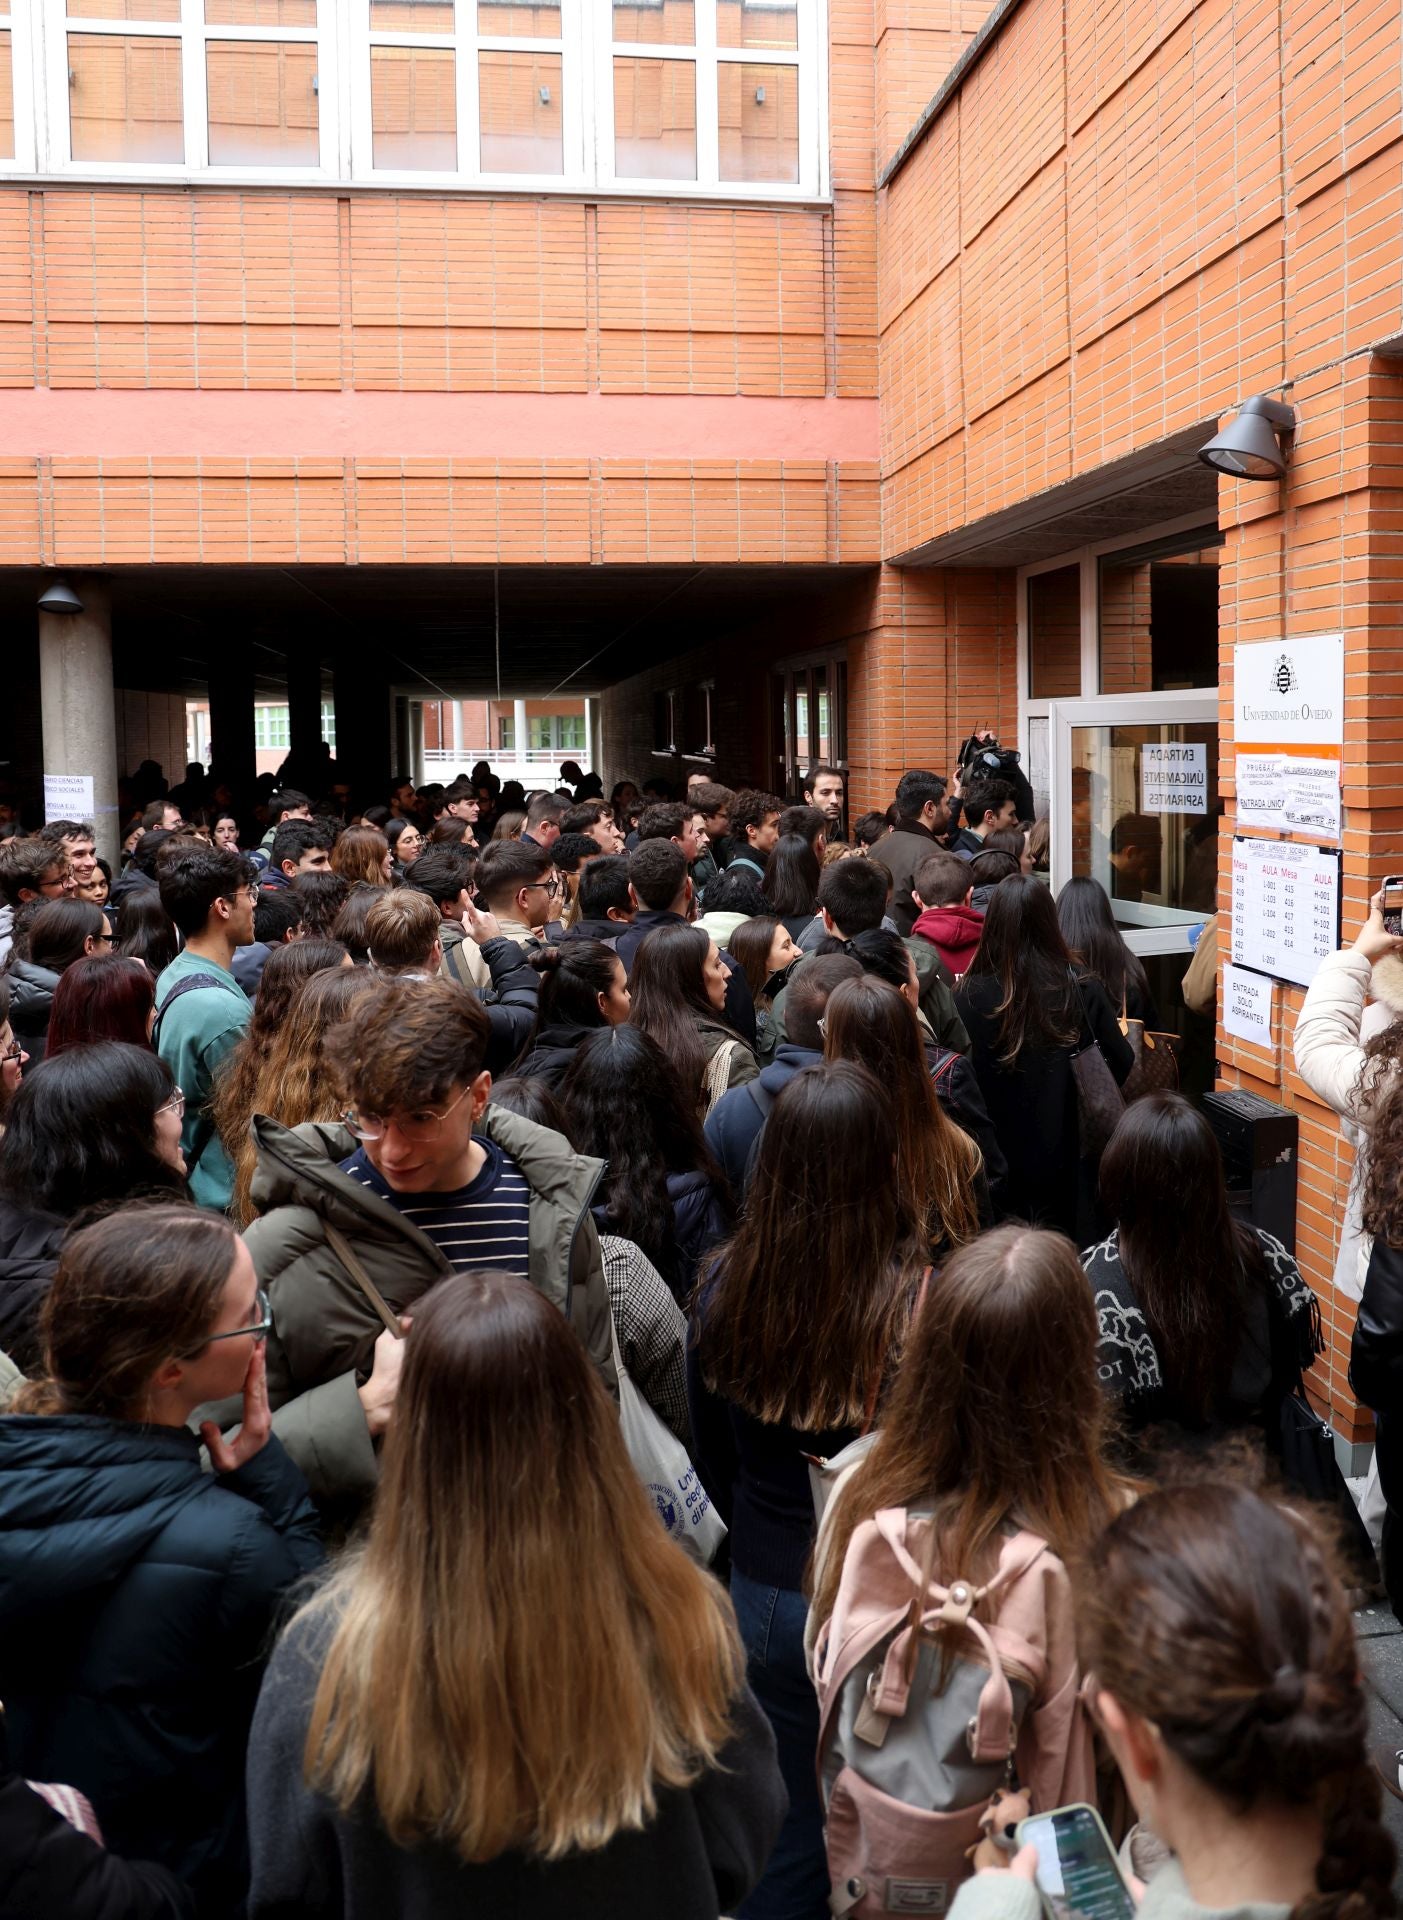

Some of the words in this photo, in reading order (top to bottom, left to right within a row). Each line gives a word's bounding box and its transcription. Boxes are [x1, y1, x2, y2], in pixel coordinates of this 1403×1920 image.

[1246, 763, 1275, 772] PRUEBAS
[1240, 798, 1266, 808] ENTRADA
[1233, 859, 1248, 871] Mesa
[1262, 864, 1278, 876] AULA
[1281, 867, 1298, 880] Mesa
[1314, 873, 1333, 886] AULA
[1313, 918, 1330, 930] H-102
[1313, 932, 1330, 944] A-101
[1232, 982, 1259, 998] ENTRADA
[1237, 995, 1253, 1009] SOLO
[1231, 1006, 1264, 1025] ASPIRANTES
